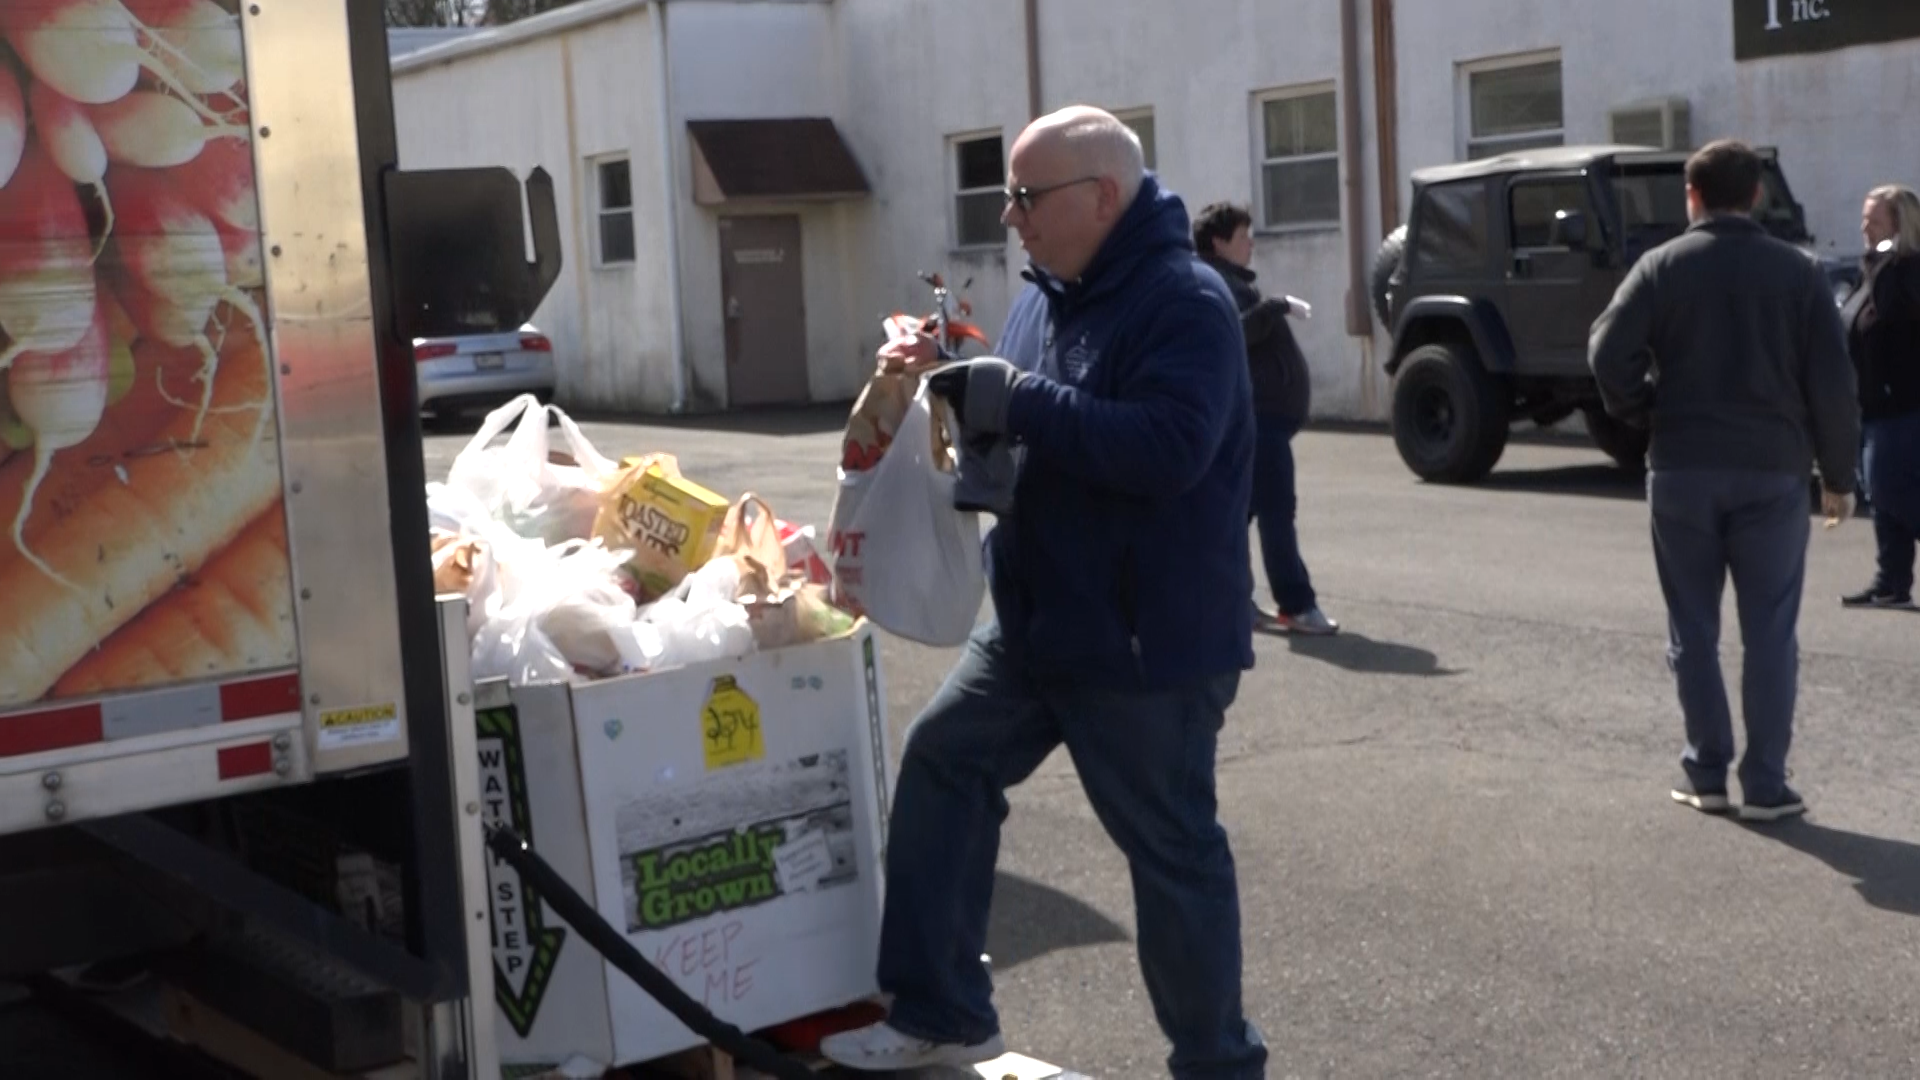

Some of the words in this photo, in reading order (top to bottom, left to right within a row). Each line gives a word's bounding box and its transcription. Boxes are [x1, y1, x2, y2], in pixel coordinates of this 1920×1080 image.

[636, 827, 784, 889] Locally
[640, 872, 776, 925] Grown
[498, 882, 523, 974] STEP
[655, 920, 744, 977] KEEP
[704, 956, 762, 1008] ME
